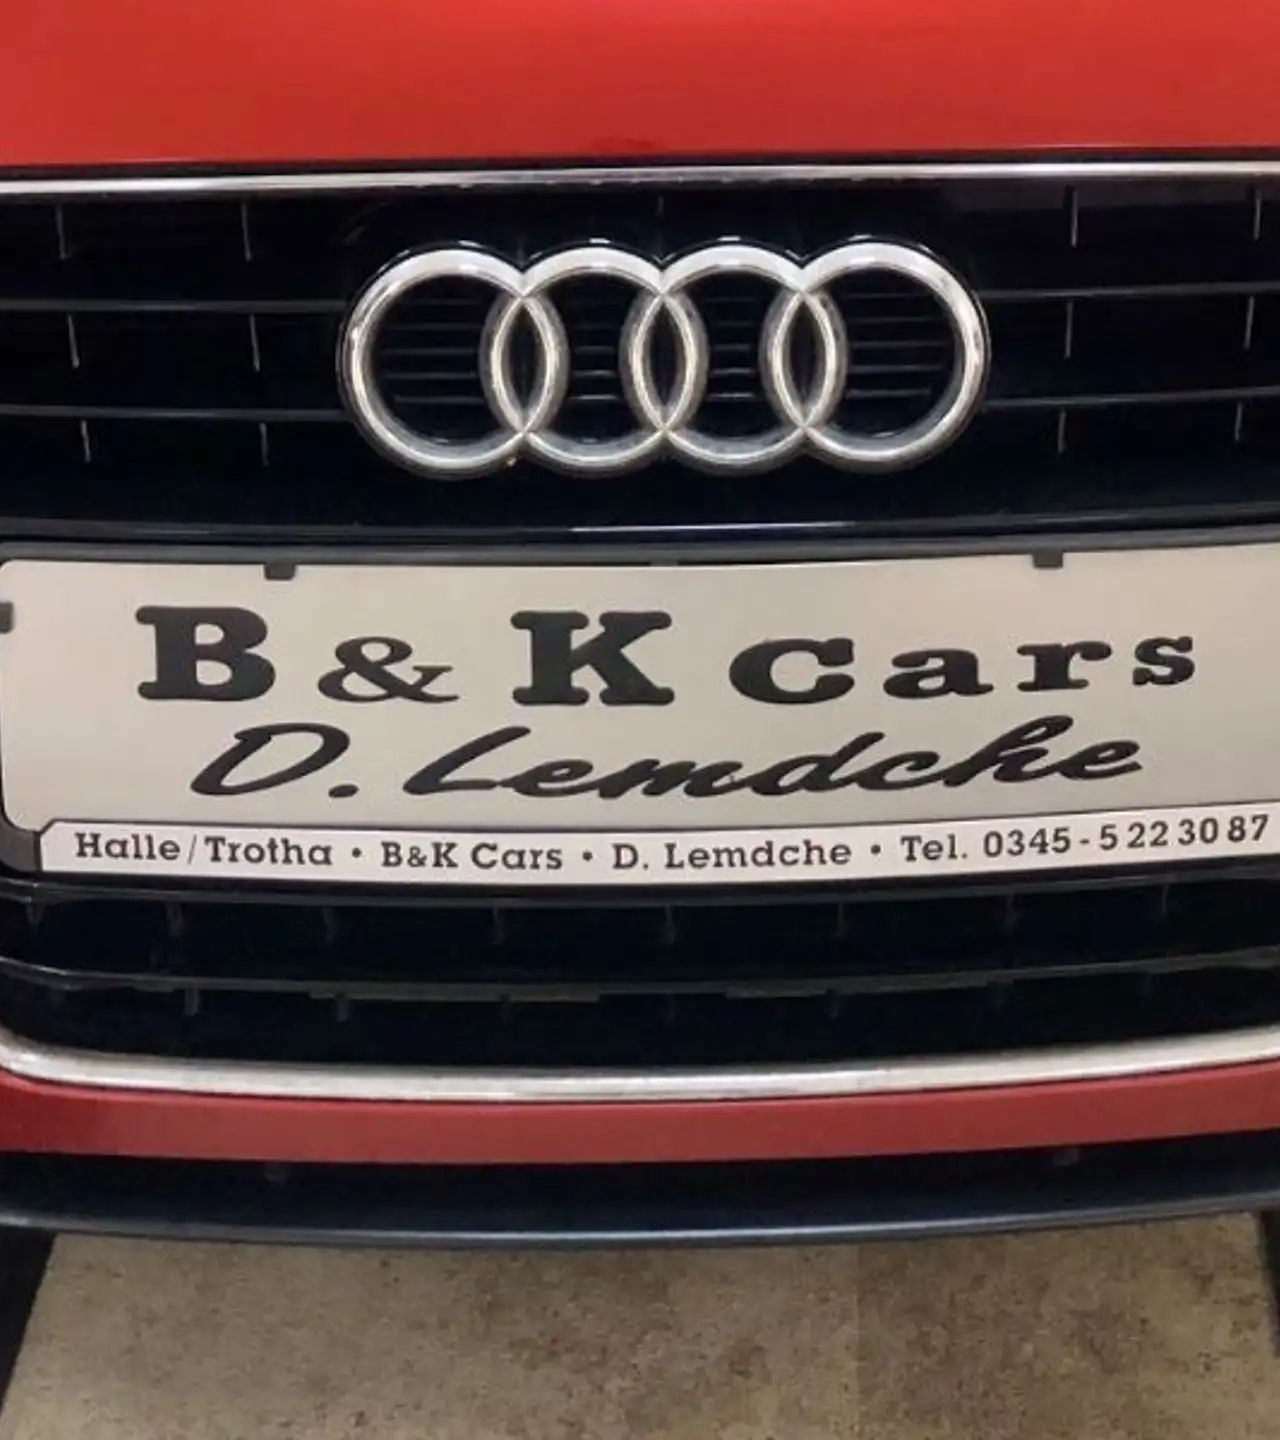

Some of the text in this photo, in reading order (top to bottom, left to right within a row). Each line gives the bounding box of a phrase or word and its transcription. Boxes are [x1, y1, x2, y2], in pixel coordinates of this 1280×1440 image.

[728, 636, 1195, 706] Cars
[190, 715, 1143, 800] D. Lemdche
[381, 842, 458, 869] B&K
[471, 842, 563, 871] Cars
[613, 843, 648, 870] D.
[665, 839, 852, 870] Lemdche
[901, 833, 970, 864] Tel.
